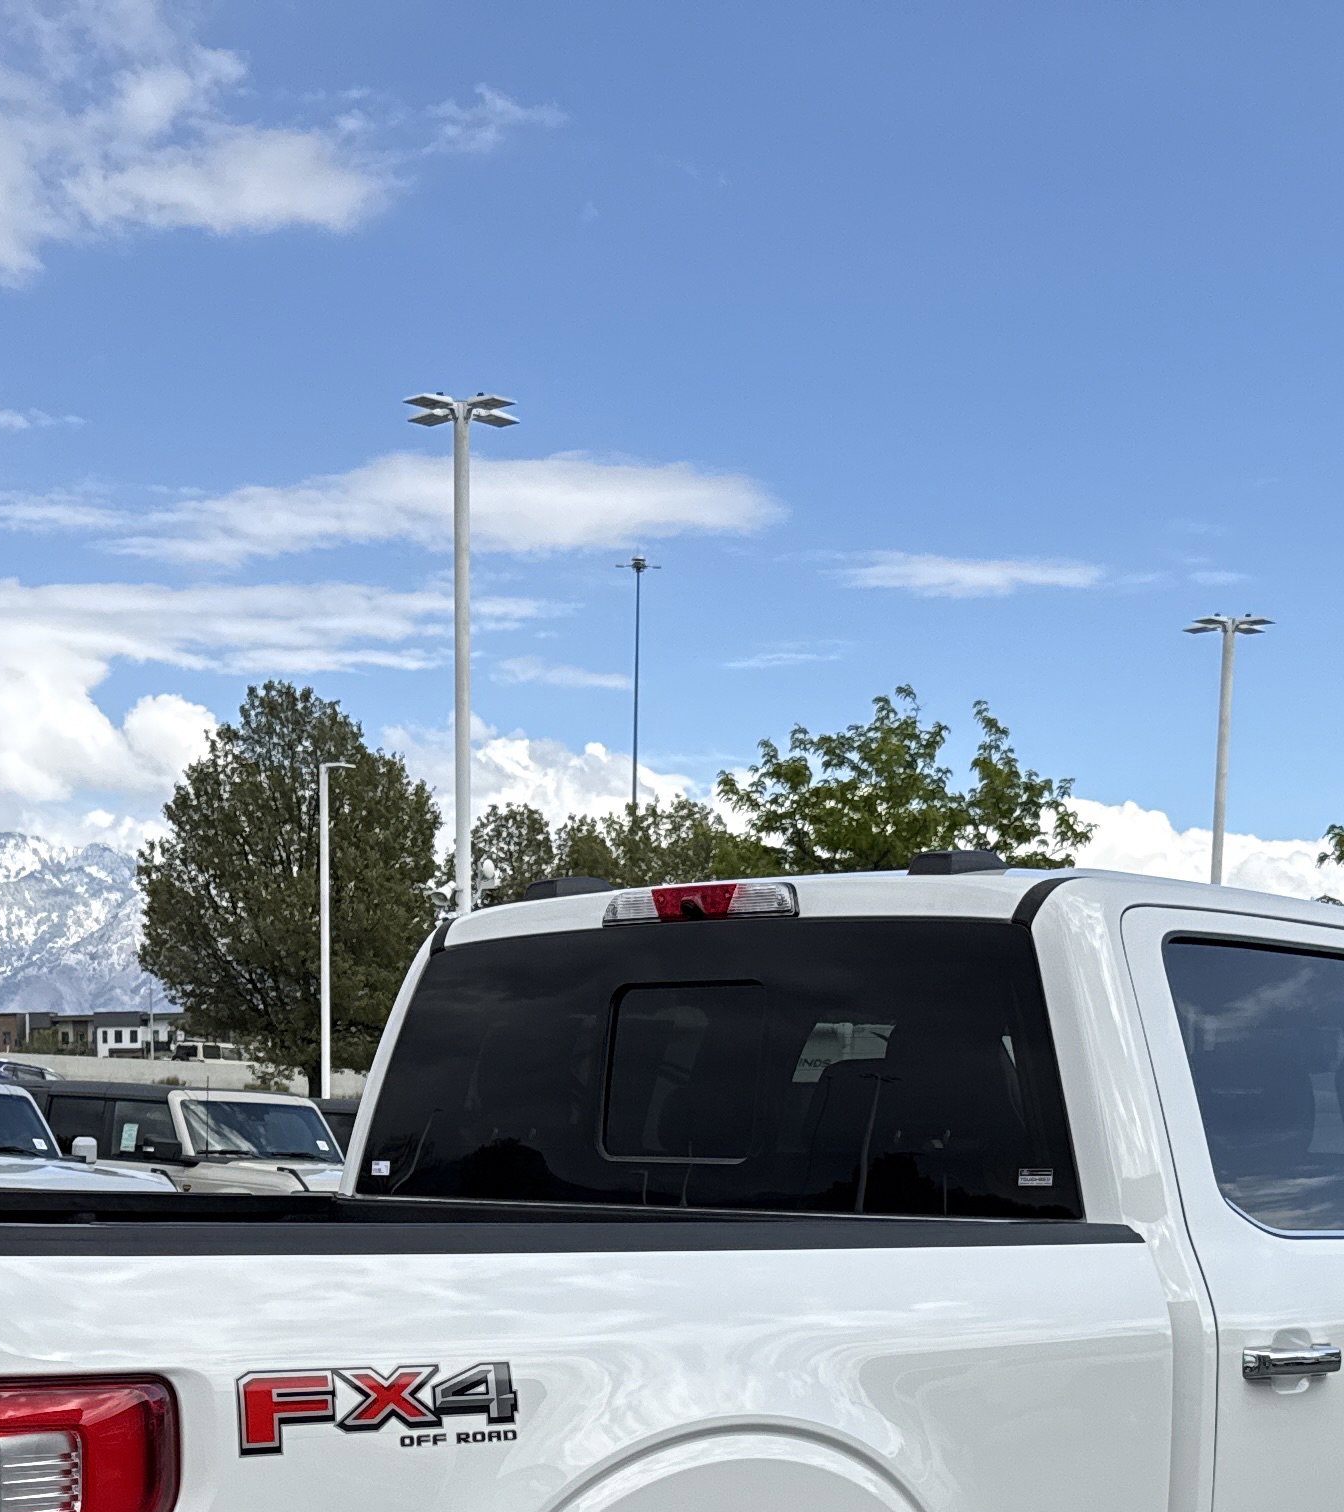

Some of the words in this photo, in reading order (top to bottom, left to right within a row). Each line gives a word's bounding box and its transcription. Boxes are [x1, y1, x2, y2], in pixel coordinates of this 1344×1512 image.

[235, 1361, 519, 1459] FX4
[400, 1432, 447, 1447] OFF
[456, 1429, 518, 1444] ROAD
